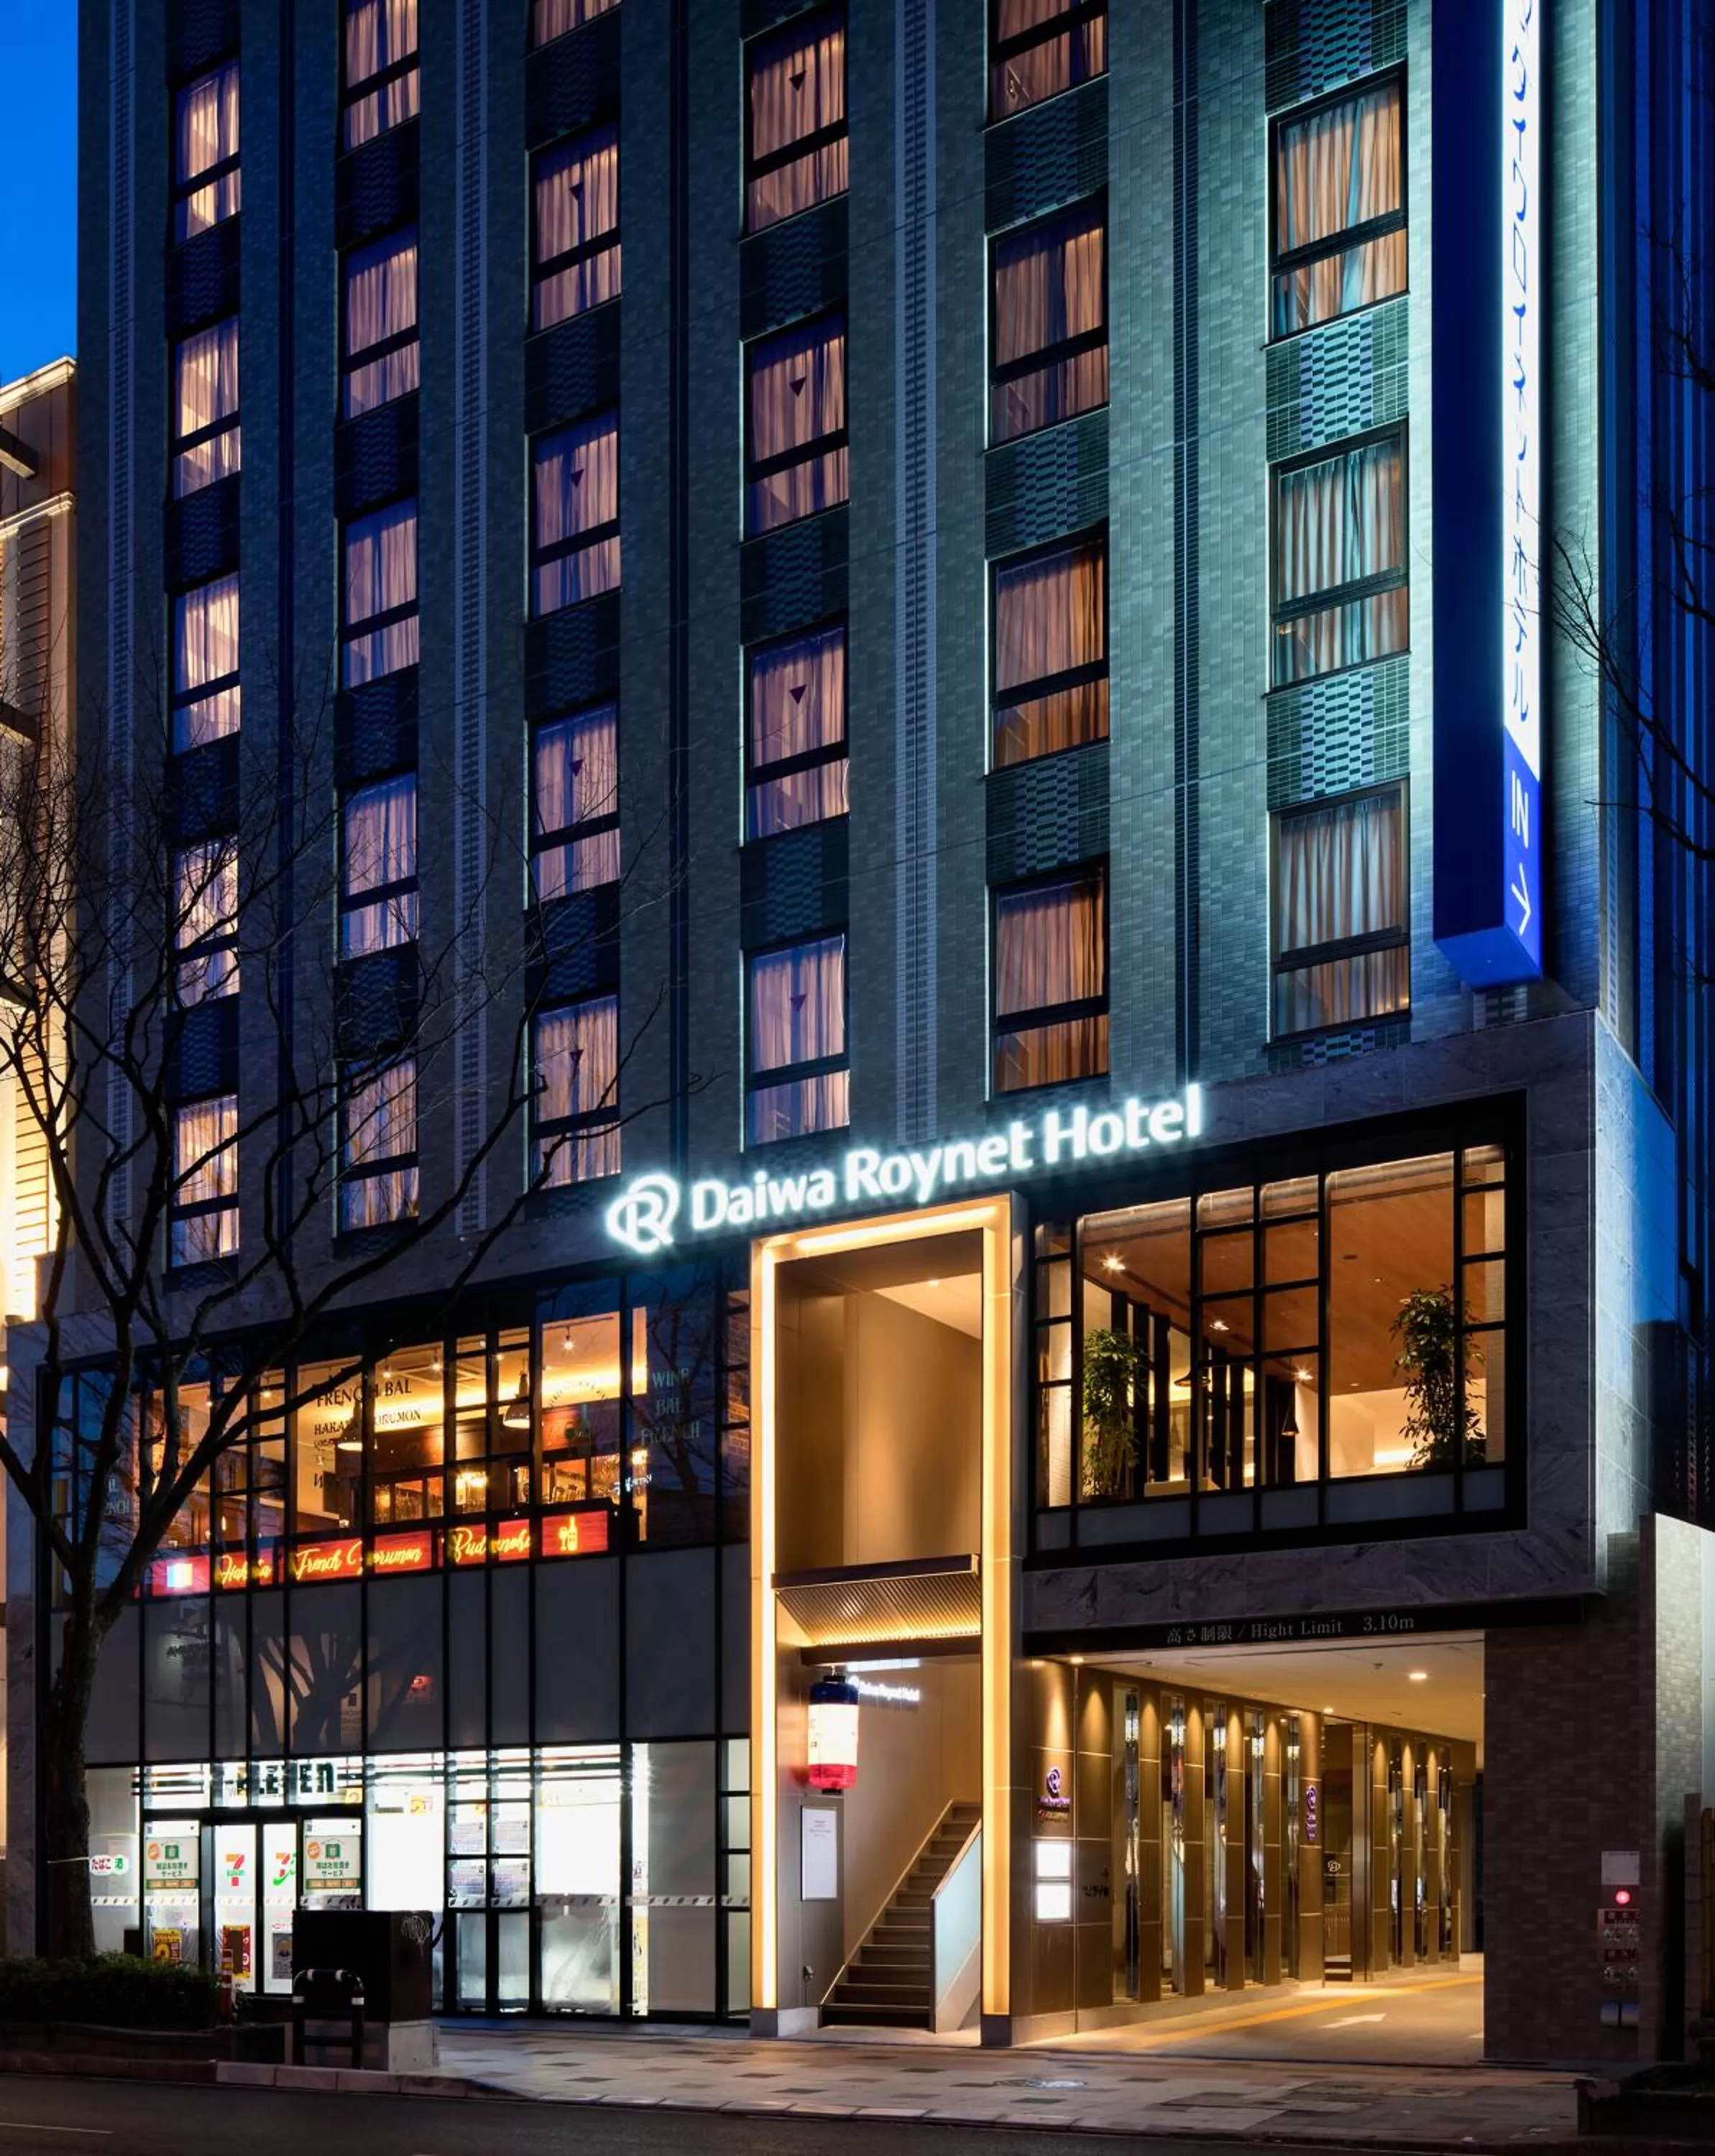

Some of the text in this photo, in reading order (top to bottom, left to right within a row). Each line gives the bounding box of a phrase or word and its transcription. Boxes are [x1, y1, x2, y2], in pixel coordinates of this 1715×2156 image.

[1512, 770, 1530, 849] IN
[692, 1168, 834, 1232] Daiwa
[845, 1120, 1034, 1204] Roynet
[1044, 1083, 1202, 1164] Hotel
[385, 1379, 412, 1396] BAL
[1167, 1626, 1233, 1645] 高さ制限
[1251, 1622, 1294, 1639] Hight
[1300, 1620, 1343, 1634] Limit
[1363, 1614, 1415, 1633] 3.10m
